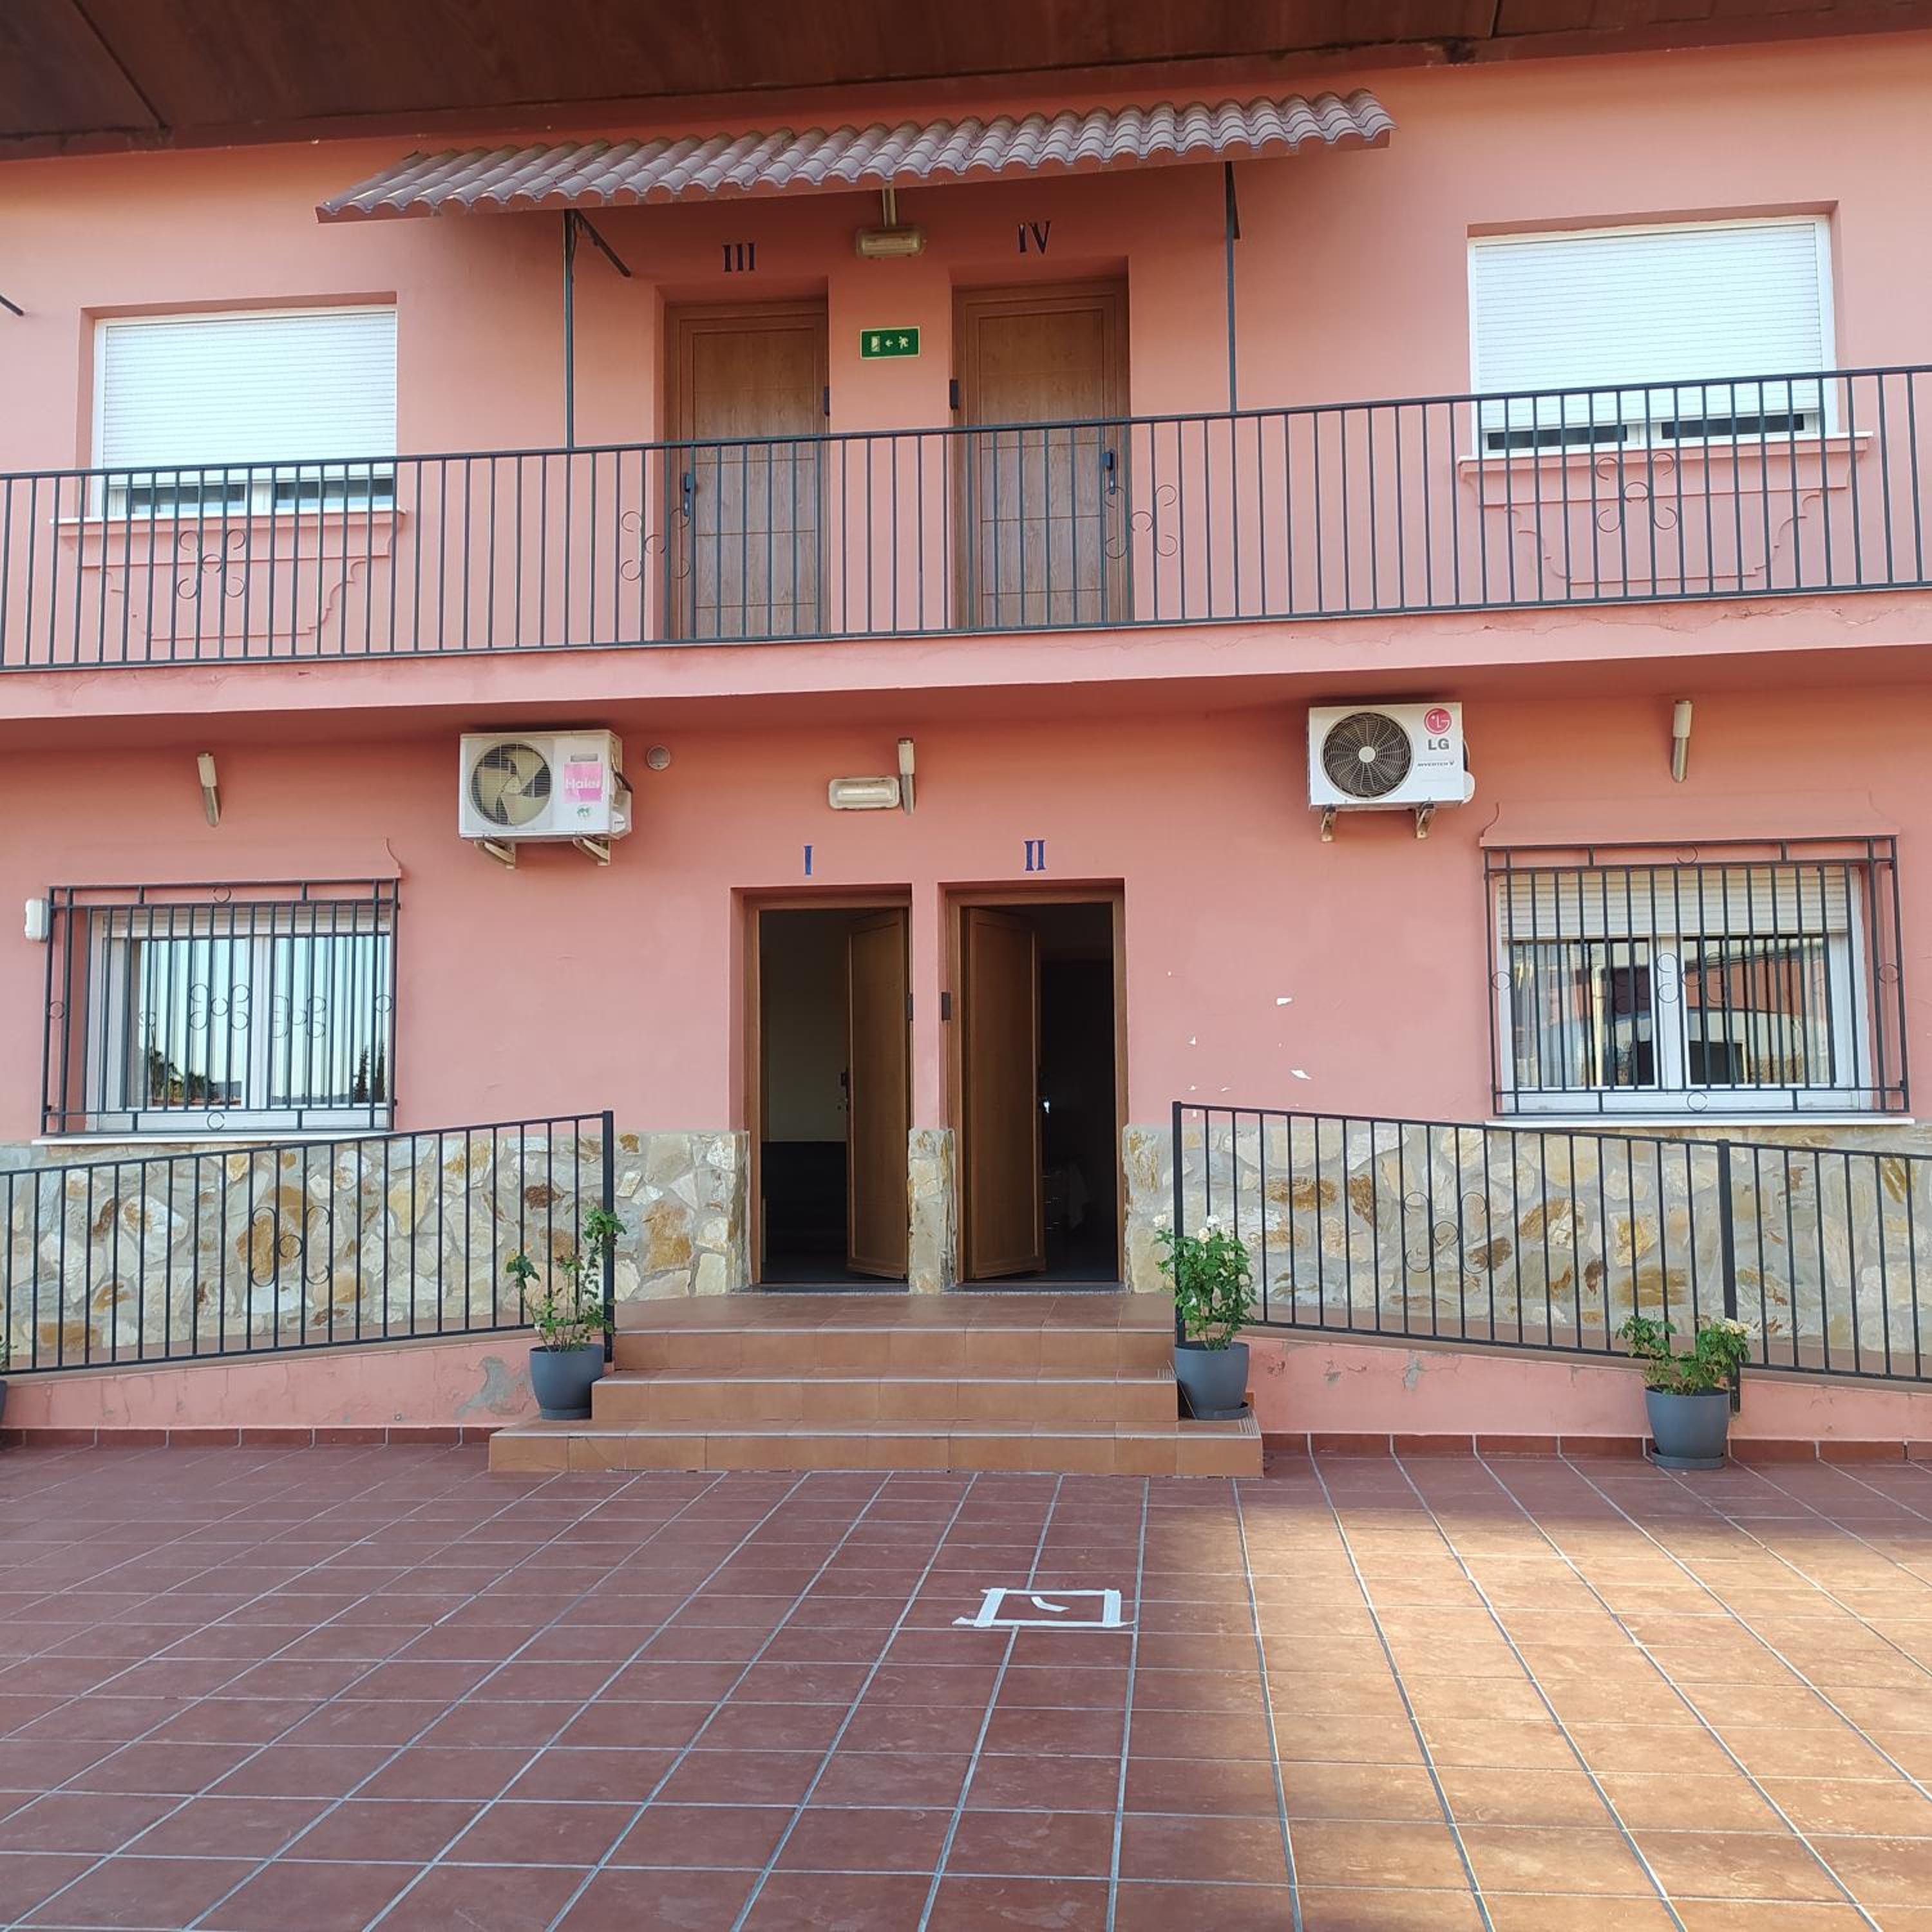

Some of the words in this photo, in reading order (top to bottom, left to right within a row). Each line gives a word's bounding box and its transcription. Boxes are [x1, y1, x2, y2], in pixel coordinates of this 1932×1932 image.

[1018, 220, 1052, 254] IV
[723, 242, 755, 272] III
[1428, 738, 1450, 750] LG
[803, 845, 813, 876] I
[1024, 839, 1046, 871] II
